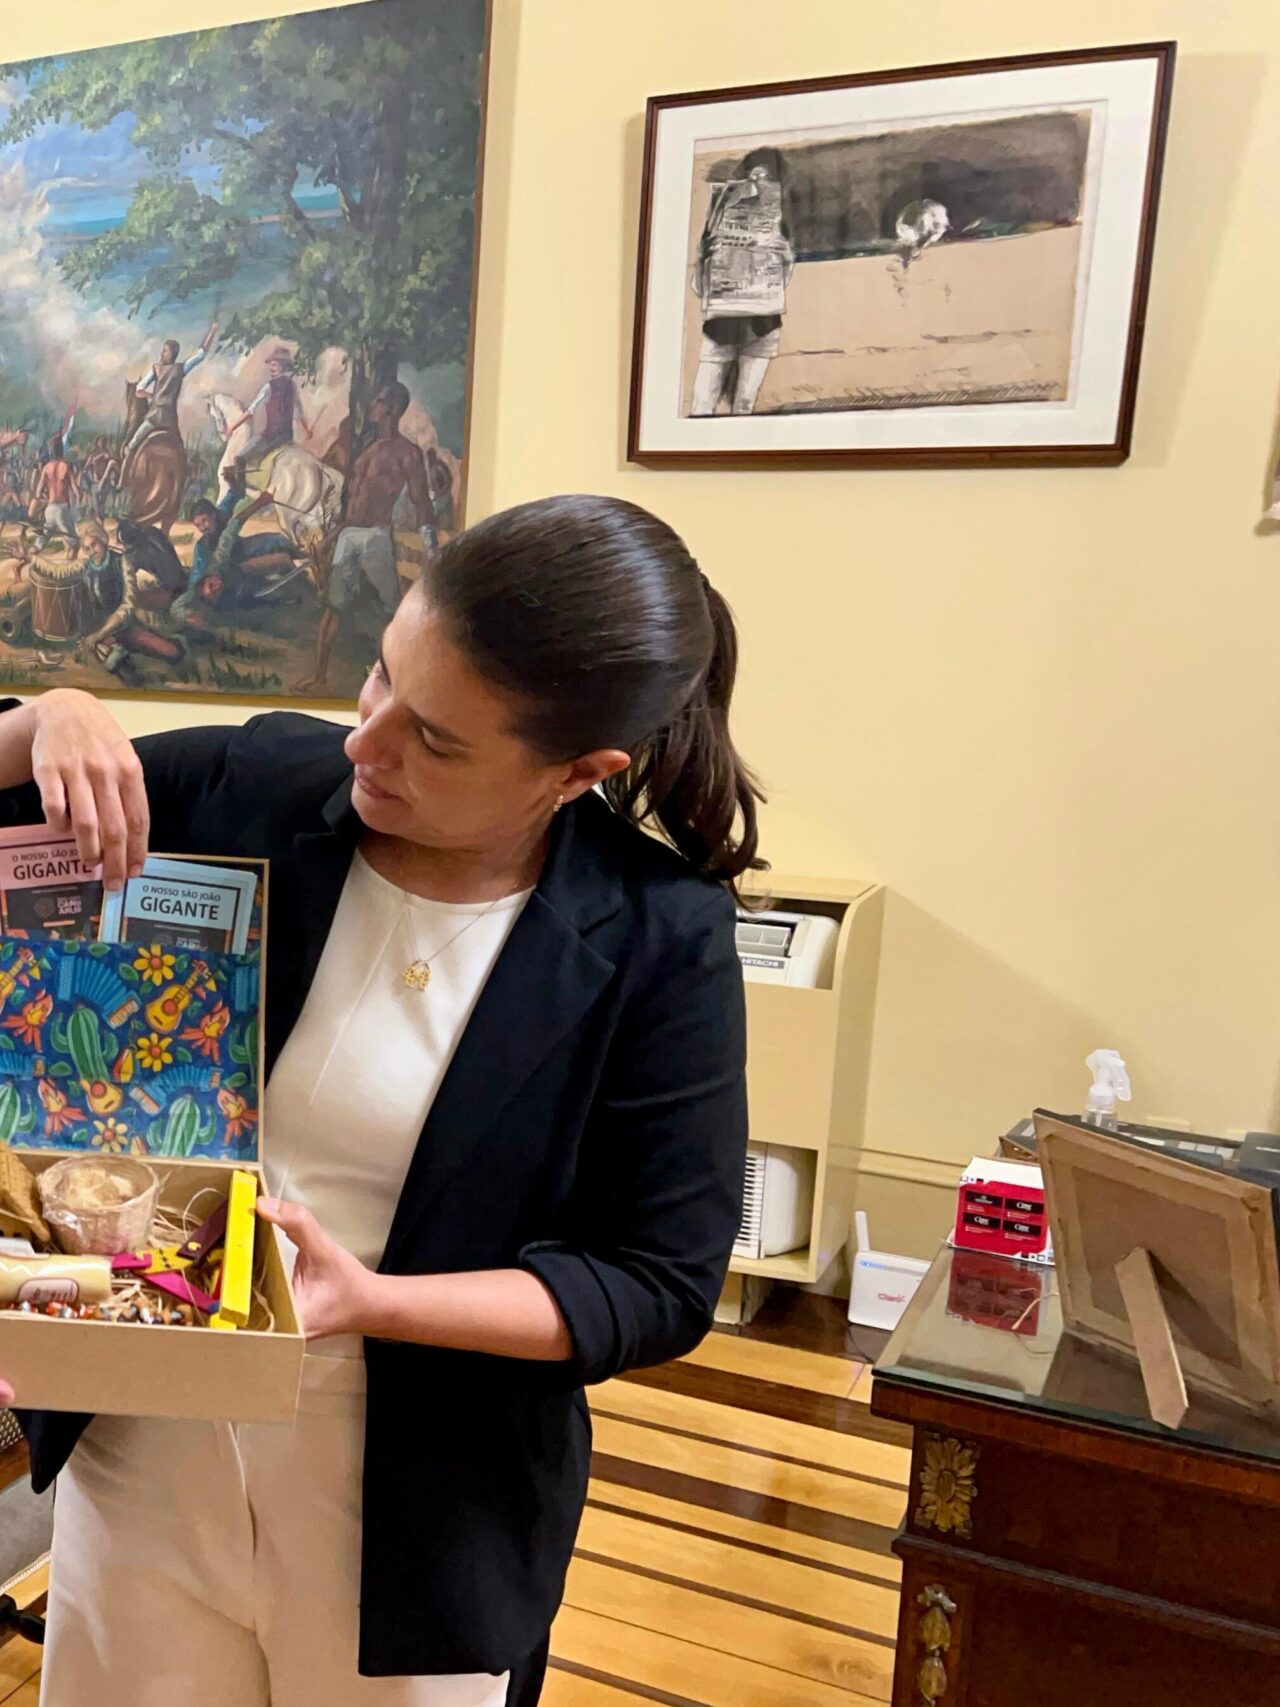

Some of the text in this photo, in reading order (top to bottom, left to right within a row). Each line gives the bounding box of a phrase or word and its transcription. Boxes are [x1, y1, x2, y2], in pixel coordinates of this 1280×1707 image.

[20, 851, 48, 861] NOSSO
[51, 849, 67, 858] SÃO
[69, 848, 79, 858] JO
[13, 859, 93, 880] GIGANTE
[142, 885, 221, 902] O NOSSO SÃO JOÃO
[140, 896, 220, 920] GIGANTE
[741, 957, 779, 967] HITACHI
